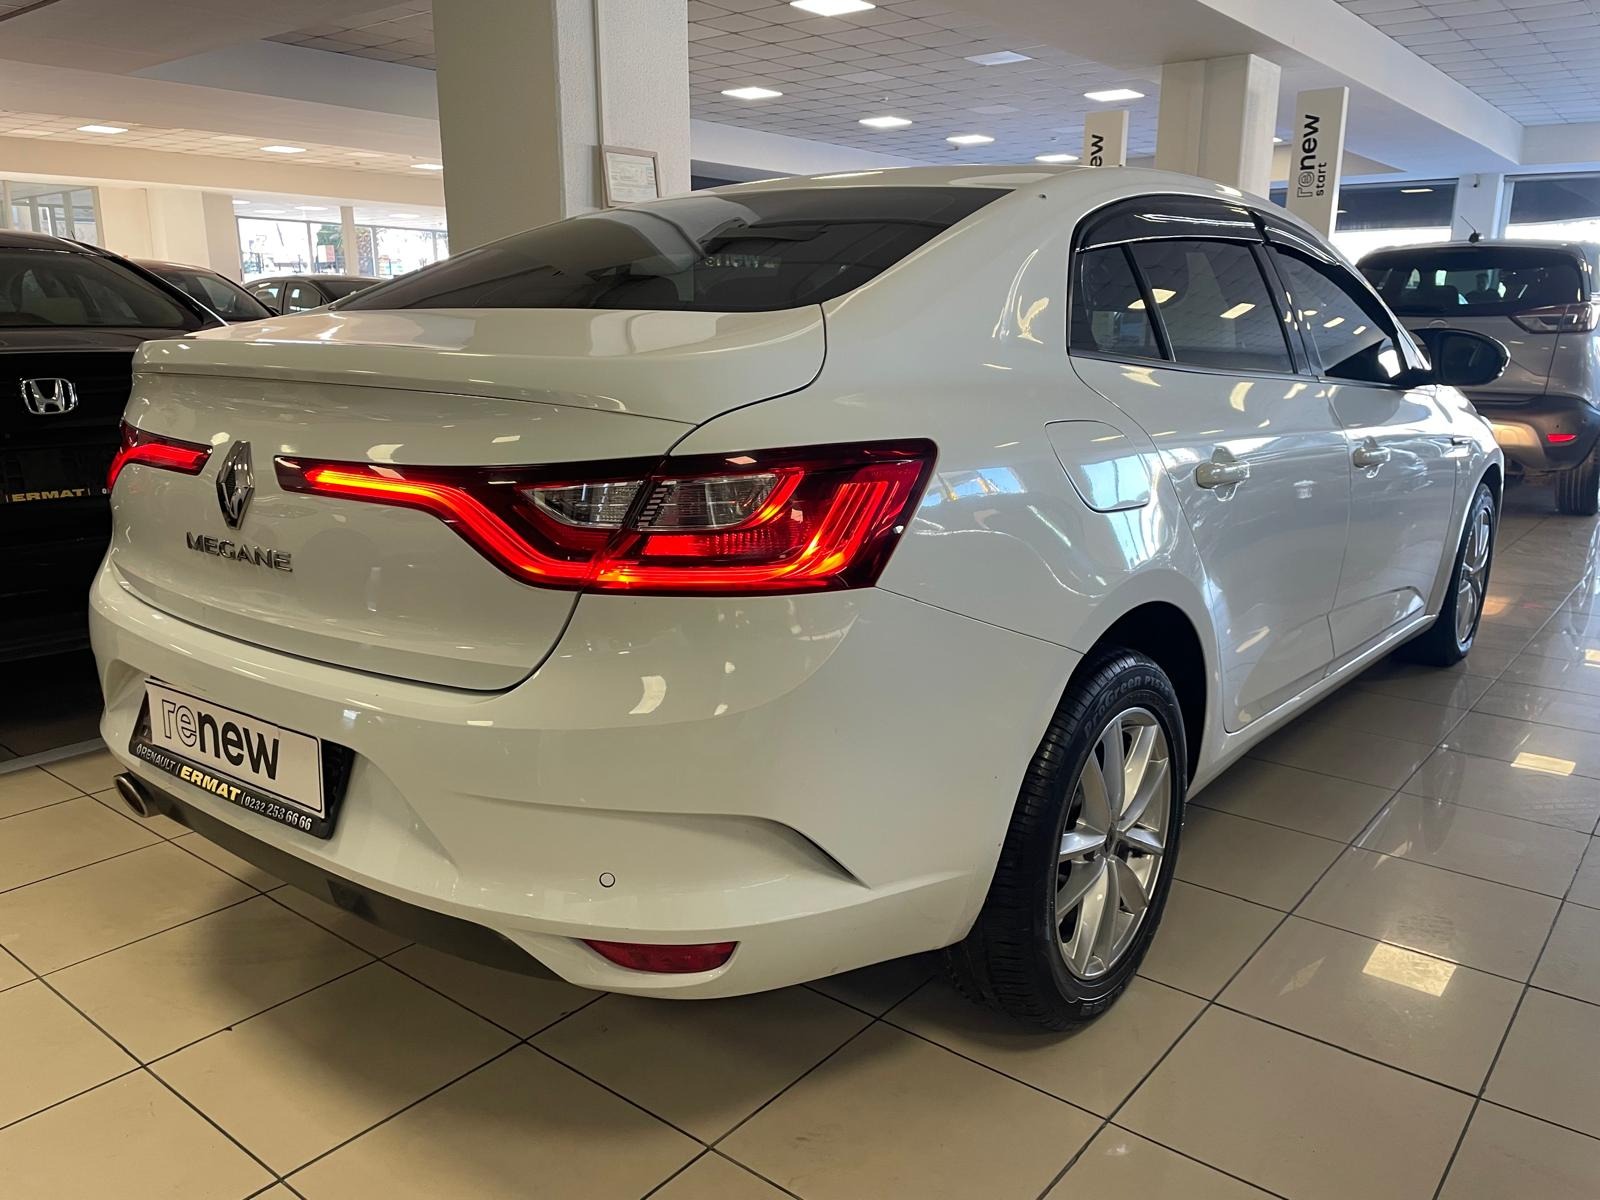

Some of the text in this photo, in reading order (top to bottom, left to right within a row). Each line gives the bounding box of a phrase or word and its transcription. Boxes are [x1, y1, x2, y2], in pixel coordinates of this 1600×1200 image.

[1296, 114, 1320, 199] renew
[1315, 162, 1327, 197] start
[11, 488, 86, 502] ERMAT
[186, 531, 293, 573] MEGANE
[161, 698, 280, 781] renew
[140, 746, 313, 831] RENAULT ERMAT 0232 253 66 66
